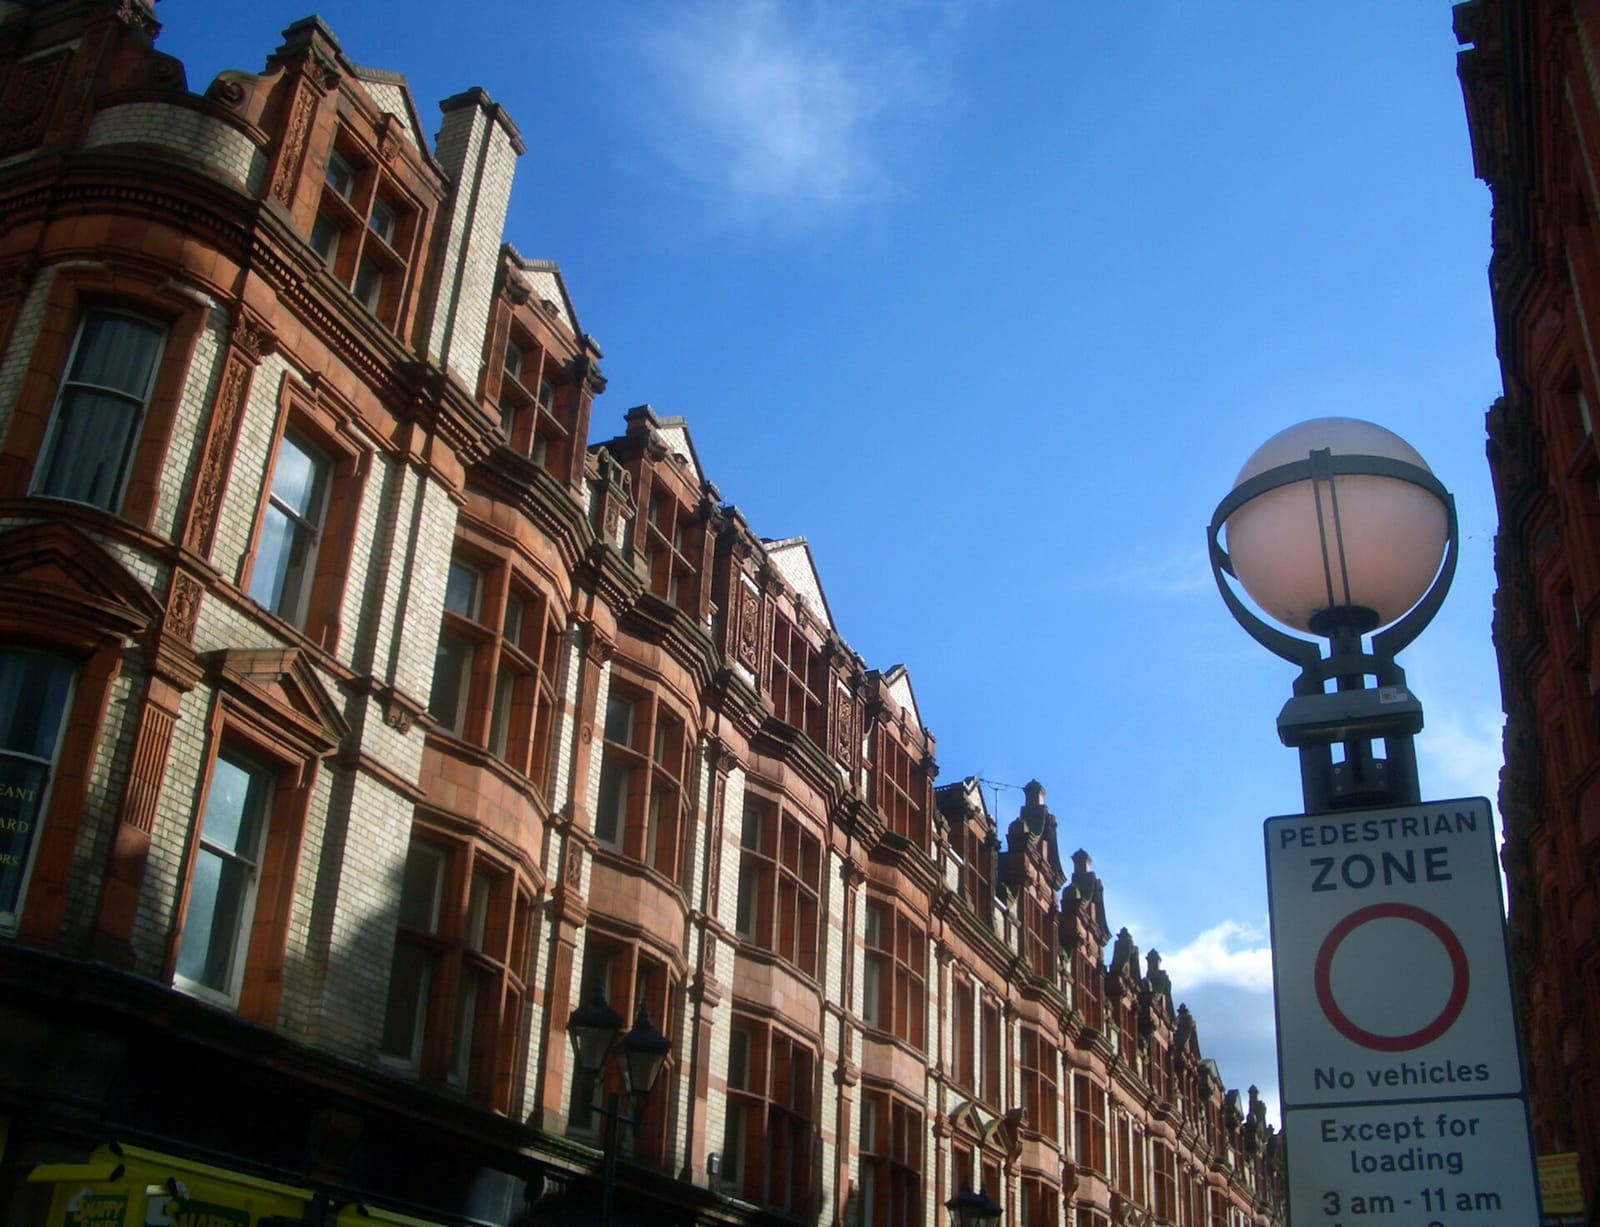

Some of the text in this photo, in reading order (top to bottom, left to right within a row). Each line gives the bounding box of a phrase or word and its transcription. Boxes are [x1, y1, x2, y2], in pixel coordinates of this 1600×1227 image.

[1280, 811, 1477, 848] PEDESTRIAN
[1310, 846, 1452, 892] ZONE
[1314, 1060, 1489, 1090] No vehicles
[1321, 1114, 1480, 1143] Except for
[1351, 1148, 1463, 1175] loading
[1322, 1190, 1341, 1216] 3
[1351, 1193, 1394, 1214] am
[1421, 1188, 1446, 1211] 11
[1457, 1191, 1501, 1211] am
